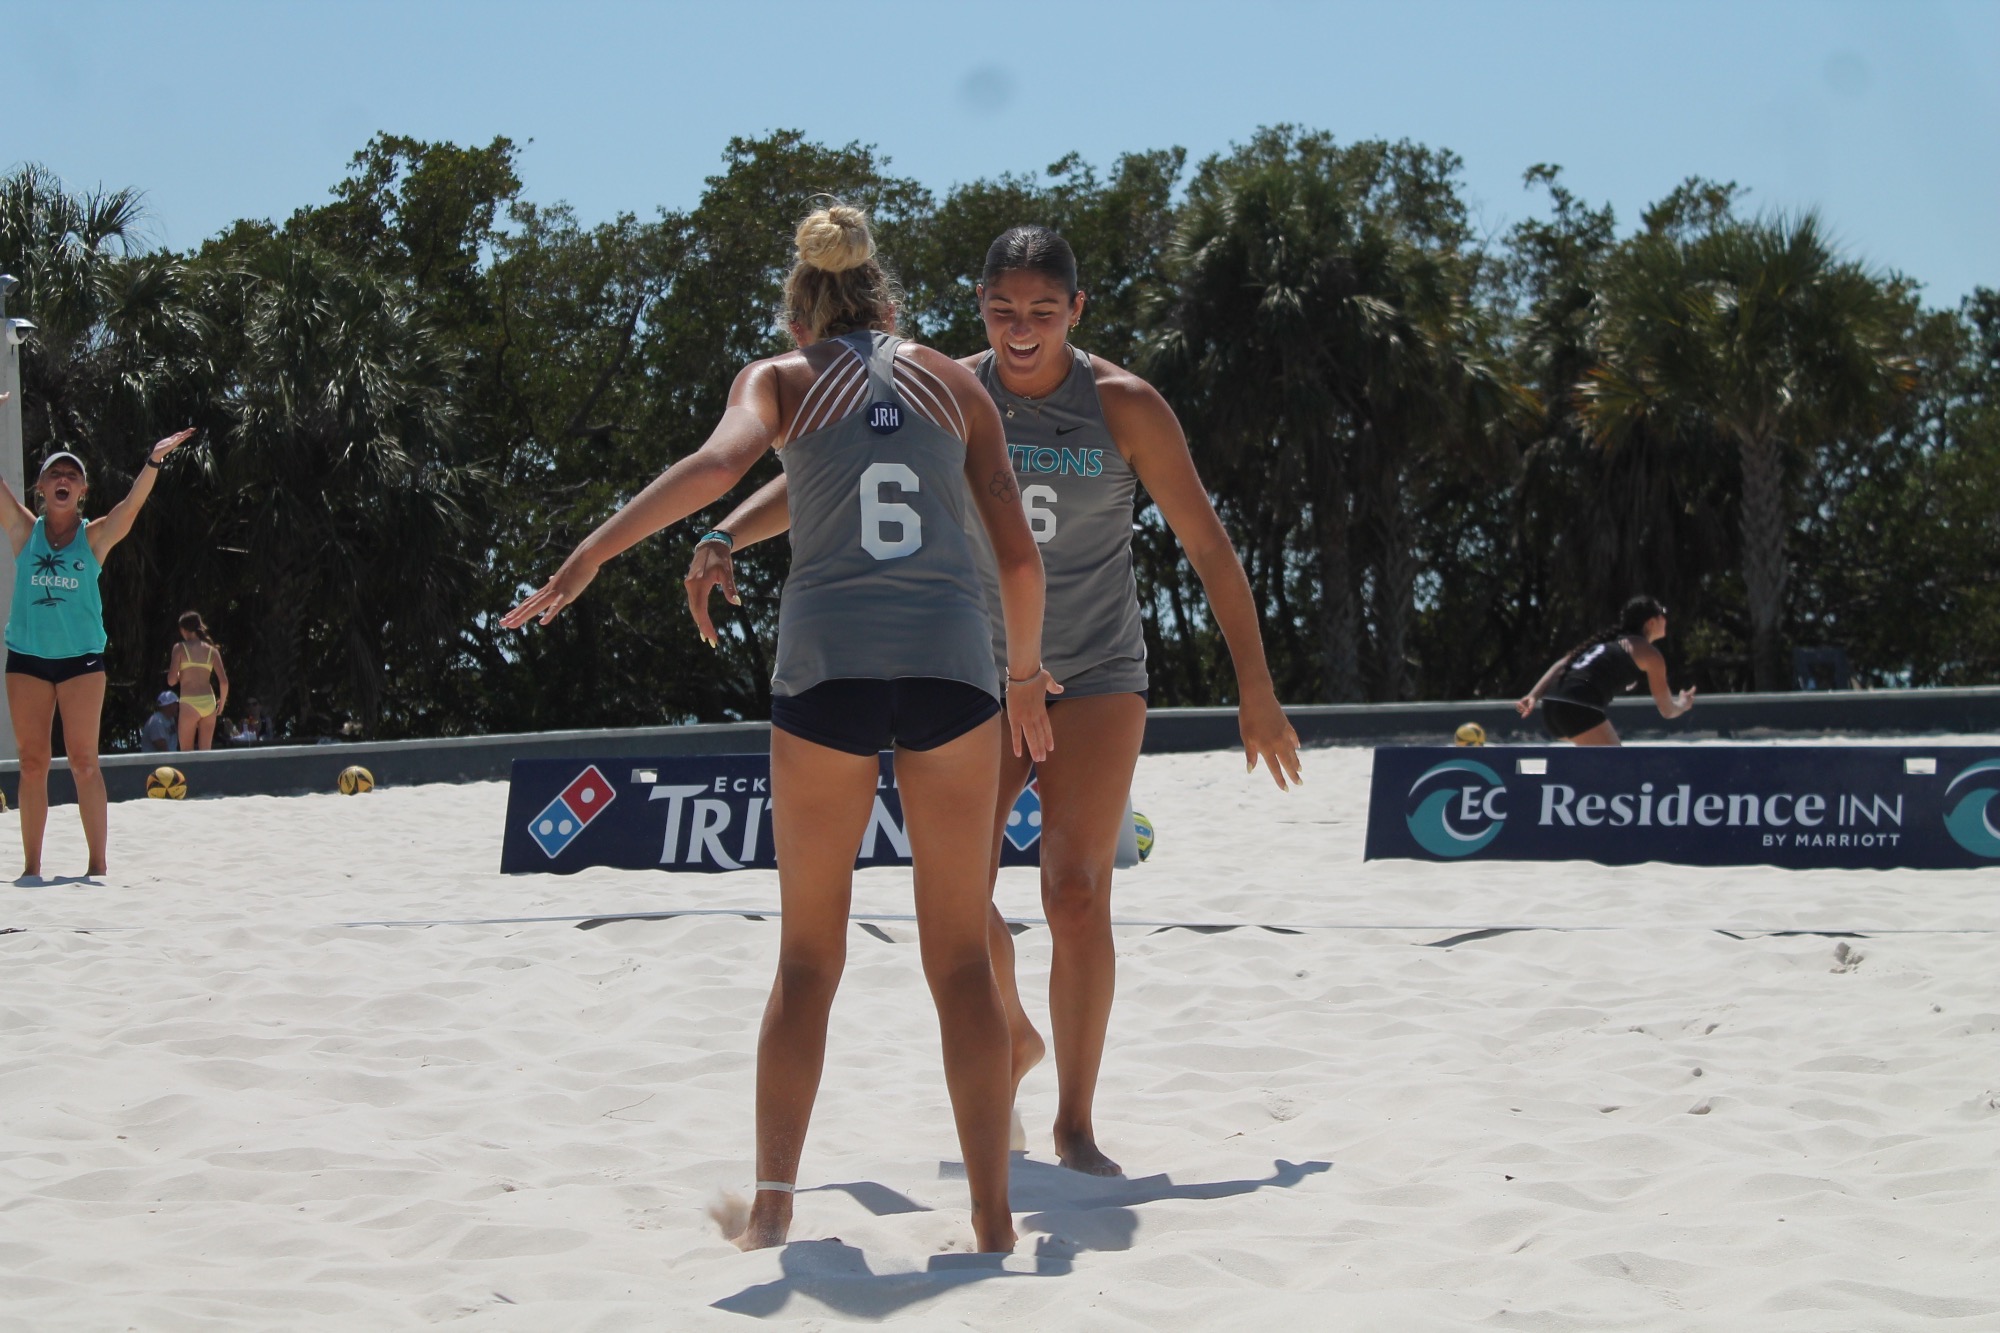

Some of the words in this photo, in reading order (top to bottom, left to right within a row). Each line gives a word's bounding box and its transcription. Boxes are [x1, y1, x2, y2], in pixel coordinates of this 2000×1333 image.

[870, 407, 899, 427] JRH
[860, 462, 922, 561] 6
[1021, 484, 1058, 544] 6
[31, 575, 79, 590] ECKERD
[713, 776, 768, 793] ECK
[1460, 786, 1508, 821] EC
[1537, 783, 1826, 827] Residence
[1838, 794, 1903, 827] INN
[647, 784, 914, 870] TRIN
[1762, 833, 1788, 847] BY
[1795, 833, 1901, 848] MARRIOTT
